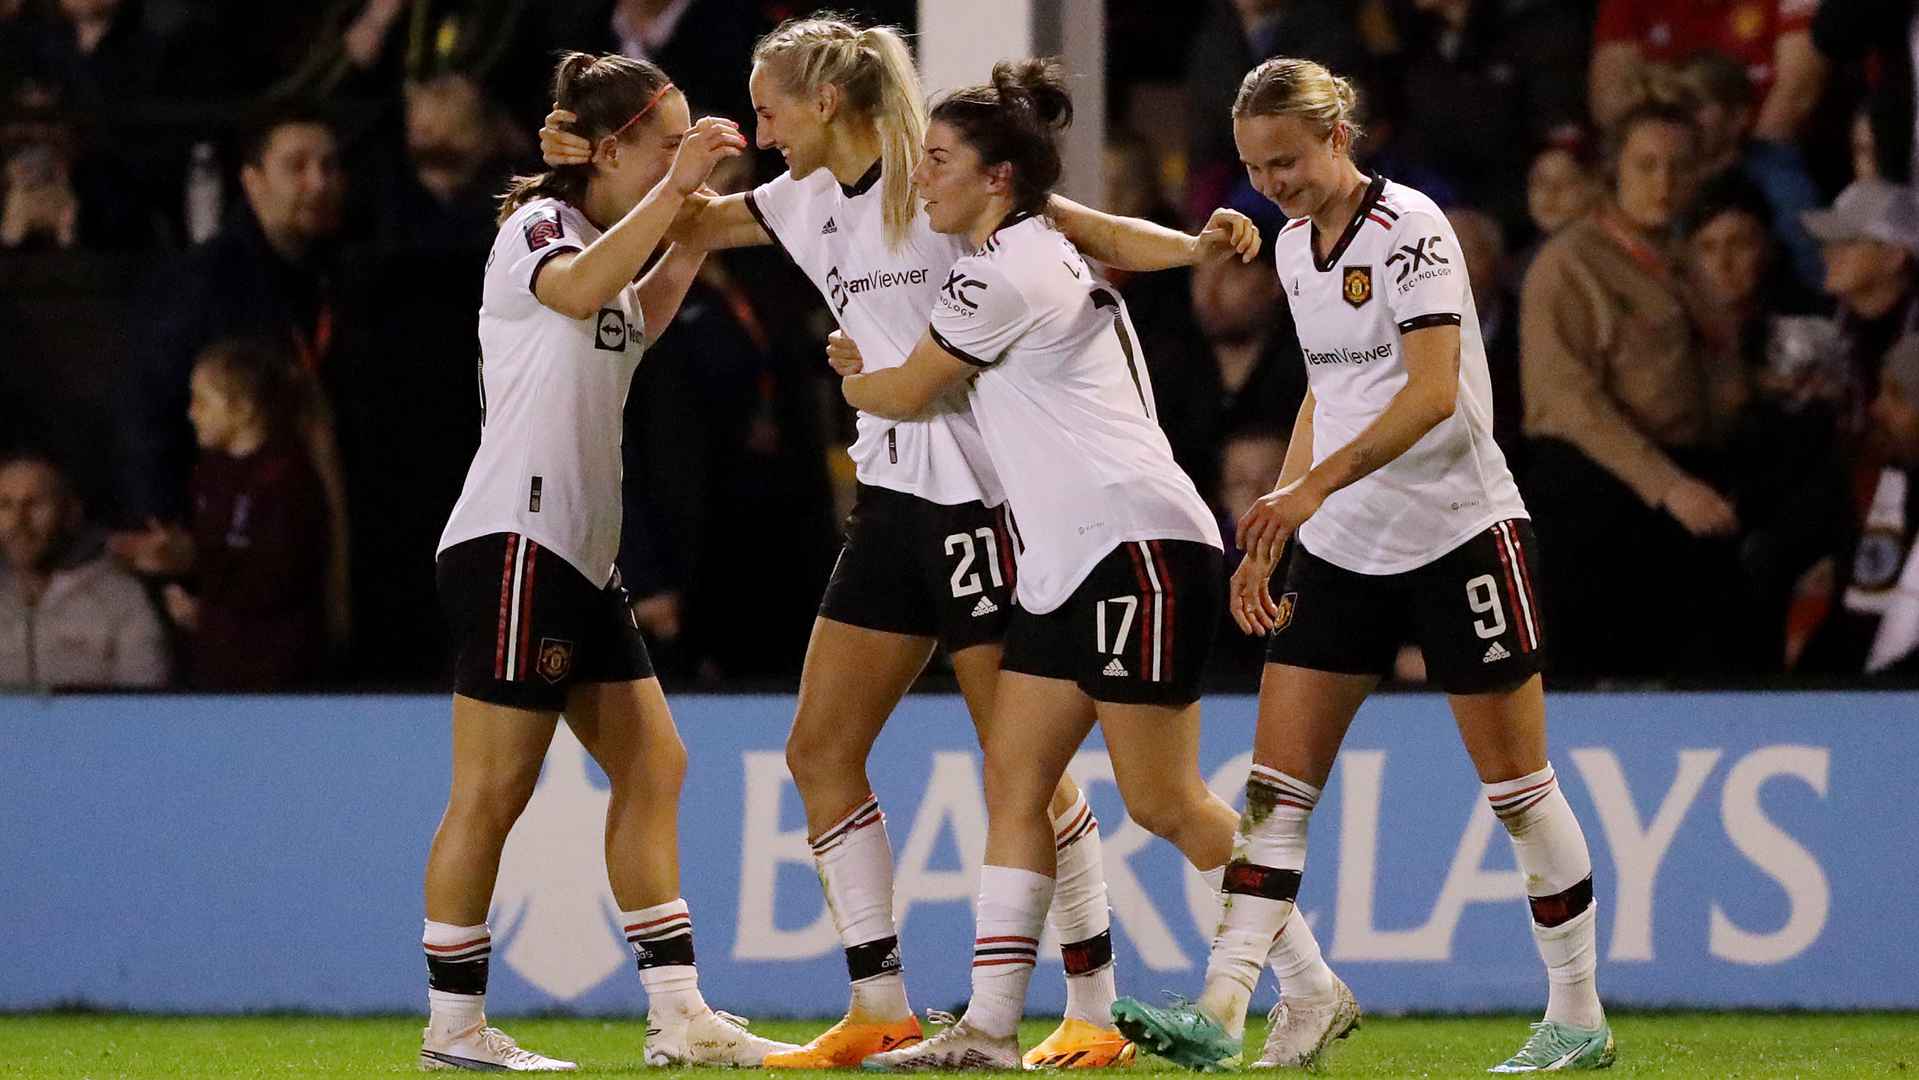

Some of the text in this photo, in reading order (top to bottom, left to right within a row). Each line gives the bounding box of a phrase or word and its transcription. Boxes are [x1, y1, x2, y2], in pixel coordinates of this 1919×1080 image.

[838, 268, 929, 294] eamViewer
[941, 269, 988, 310] XC
[1303, 343, 1393, 366] TeamViewer
[943, 526, 1004, 599] 21
[1096, 595, 1138, 655] 17
[1465, 573, 1507, 640] 9
[731, 745, 1831, 967] BARLAYS
